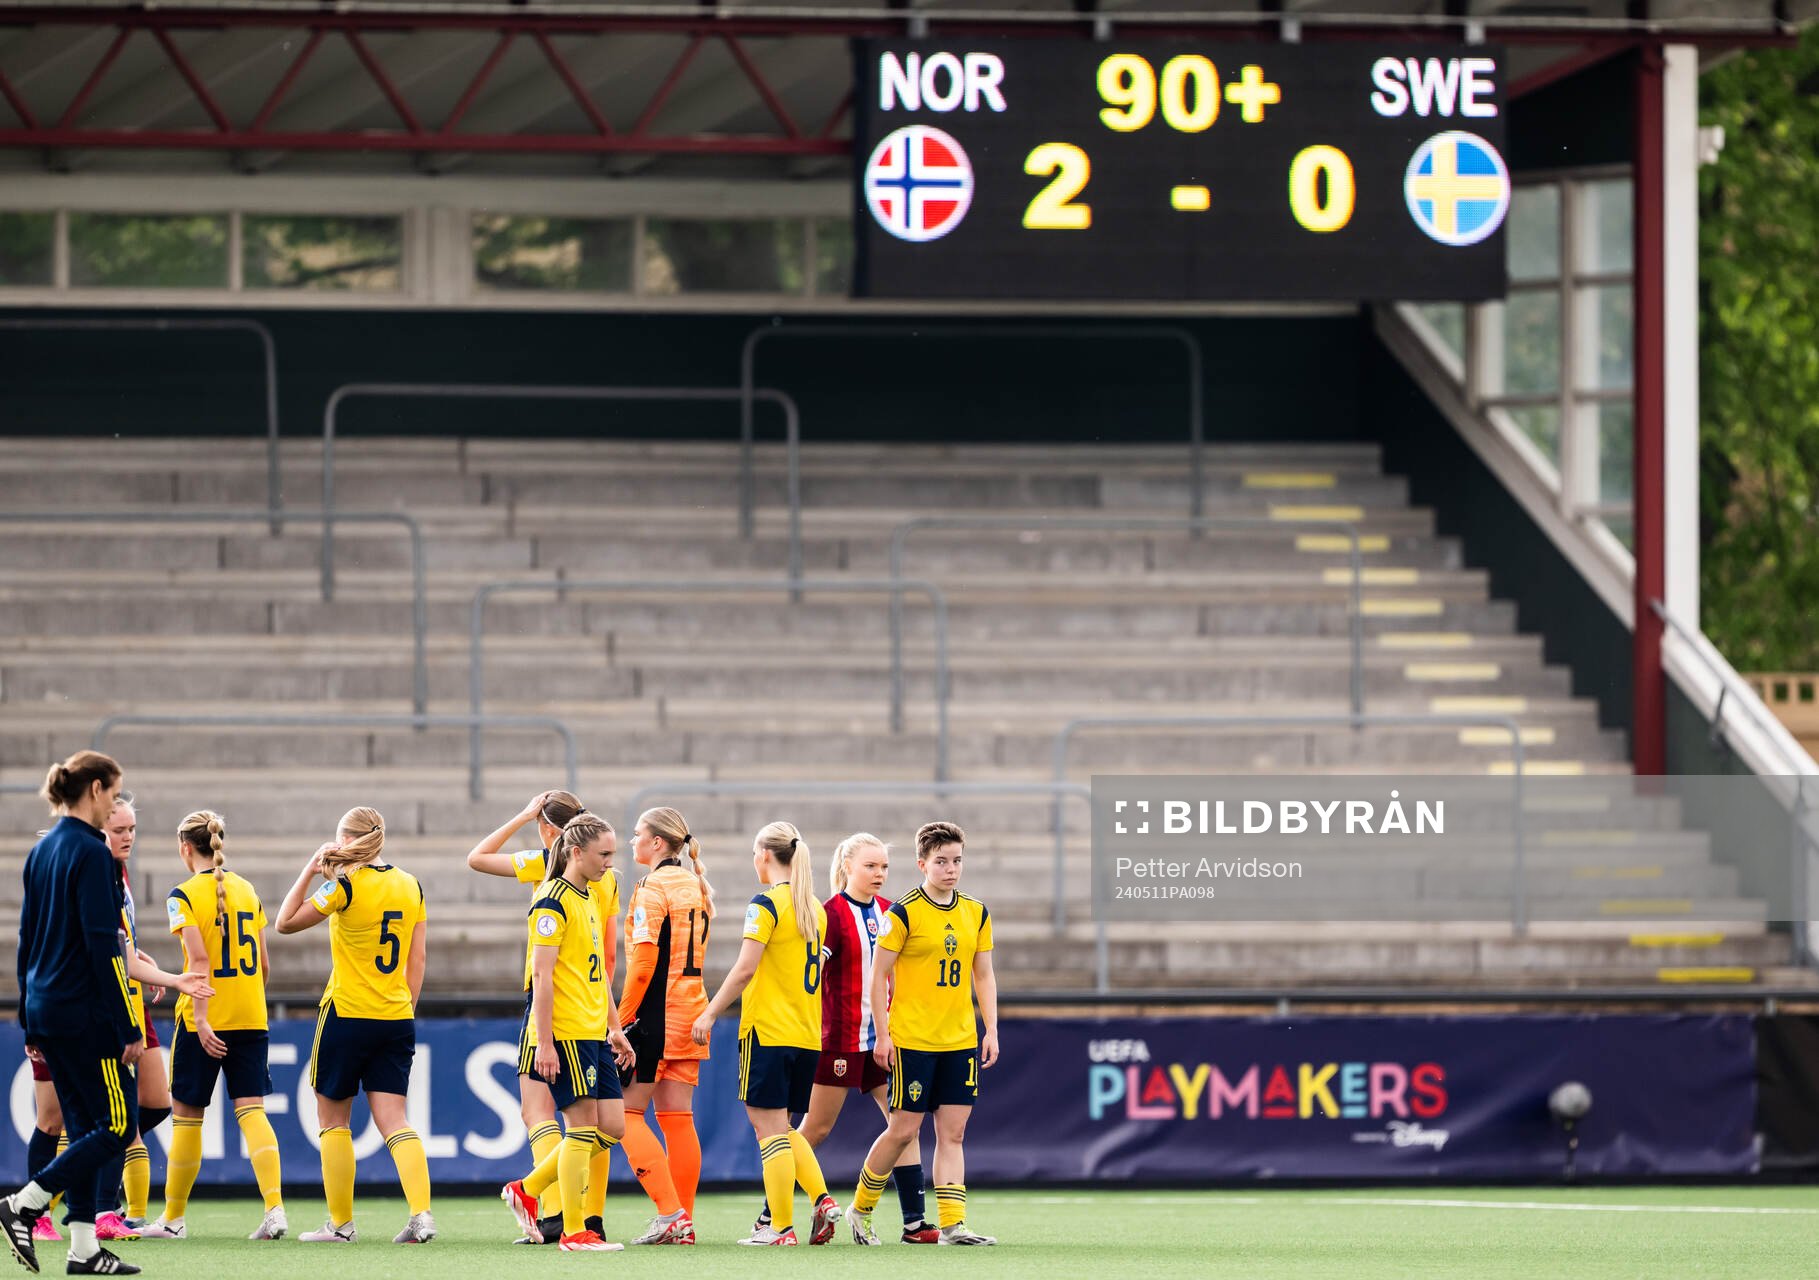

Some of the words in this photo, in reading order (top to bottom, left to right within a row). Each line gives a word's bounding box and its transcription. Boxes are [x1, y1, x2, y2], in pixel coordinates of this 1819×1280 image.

[879, 51, 1007, 112] NOR
[1096, 53, 1281, 132] 90+
[1370, 56, 1498, 117] SWE
[1022, 142, 1092, 229] 2
[1289, 145, 1356, 233] 0
[213, 911, 257, 977] 15
[375, 911, 402, 975] 5
[804, 929, 820, 995] 8
[937, 959, 961, 987] 18
[965, 1057, 978, 1086] 1
[1088, 1040, 1150, 1062] UEFA
[1088, 1063, 1448, 1120] PLAYMAKERS
